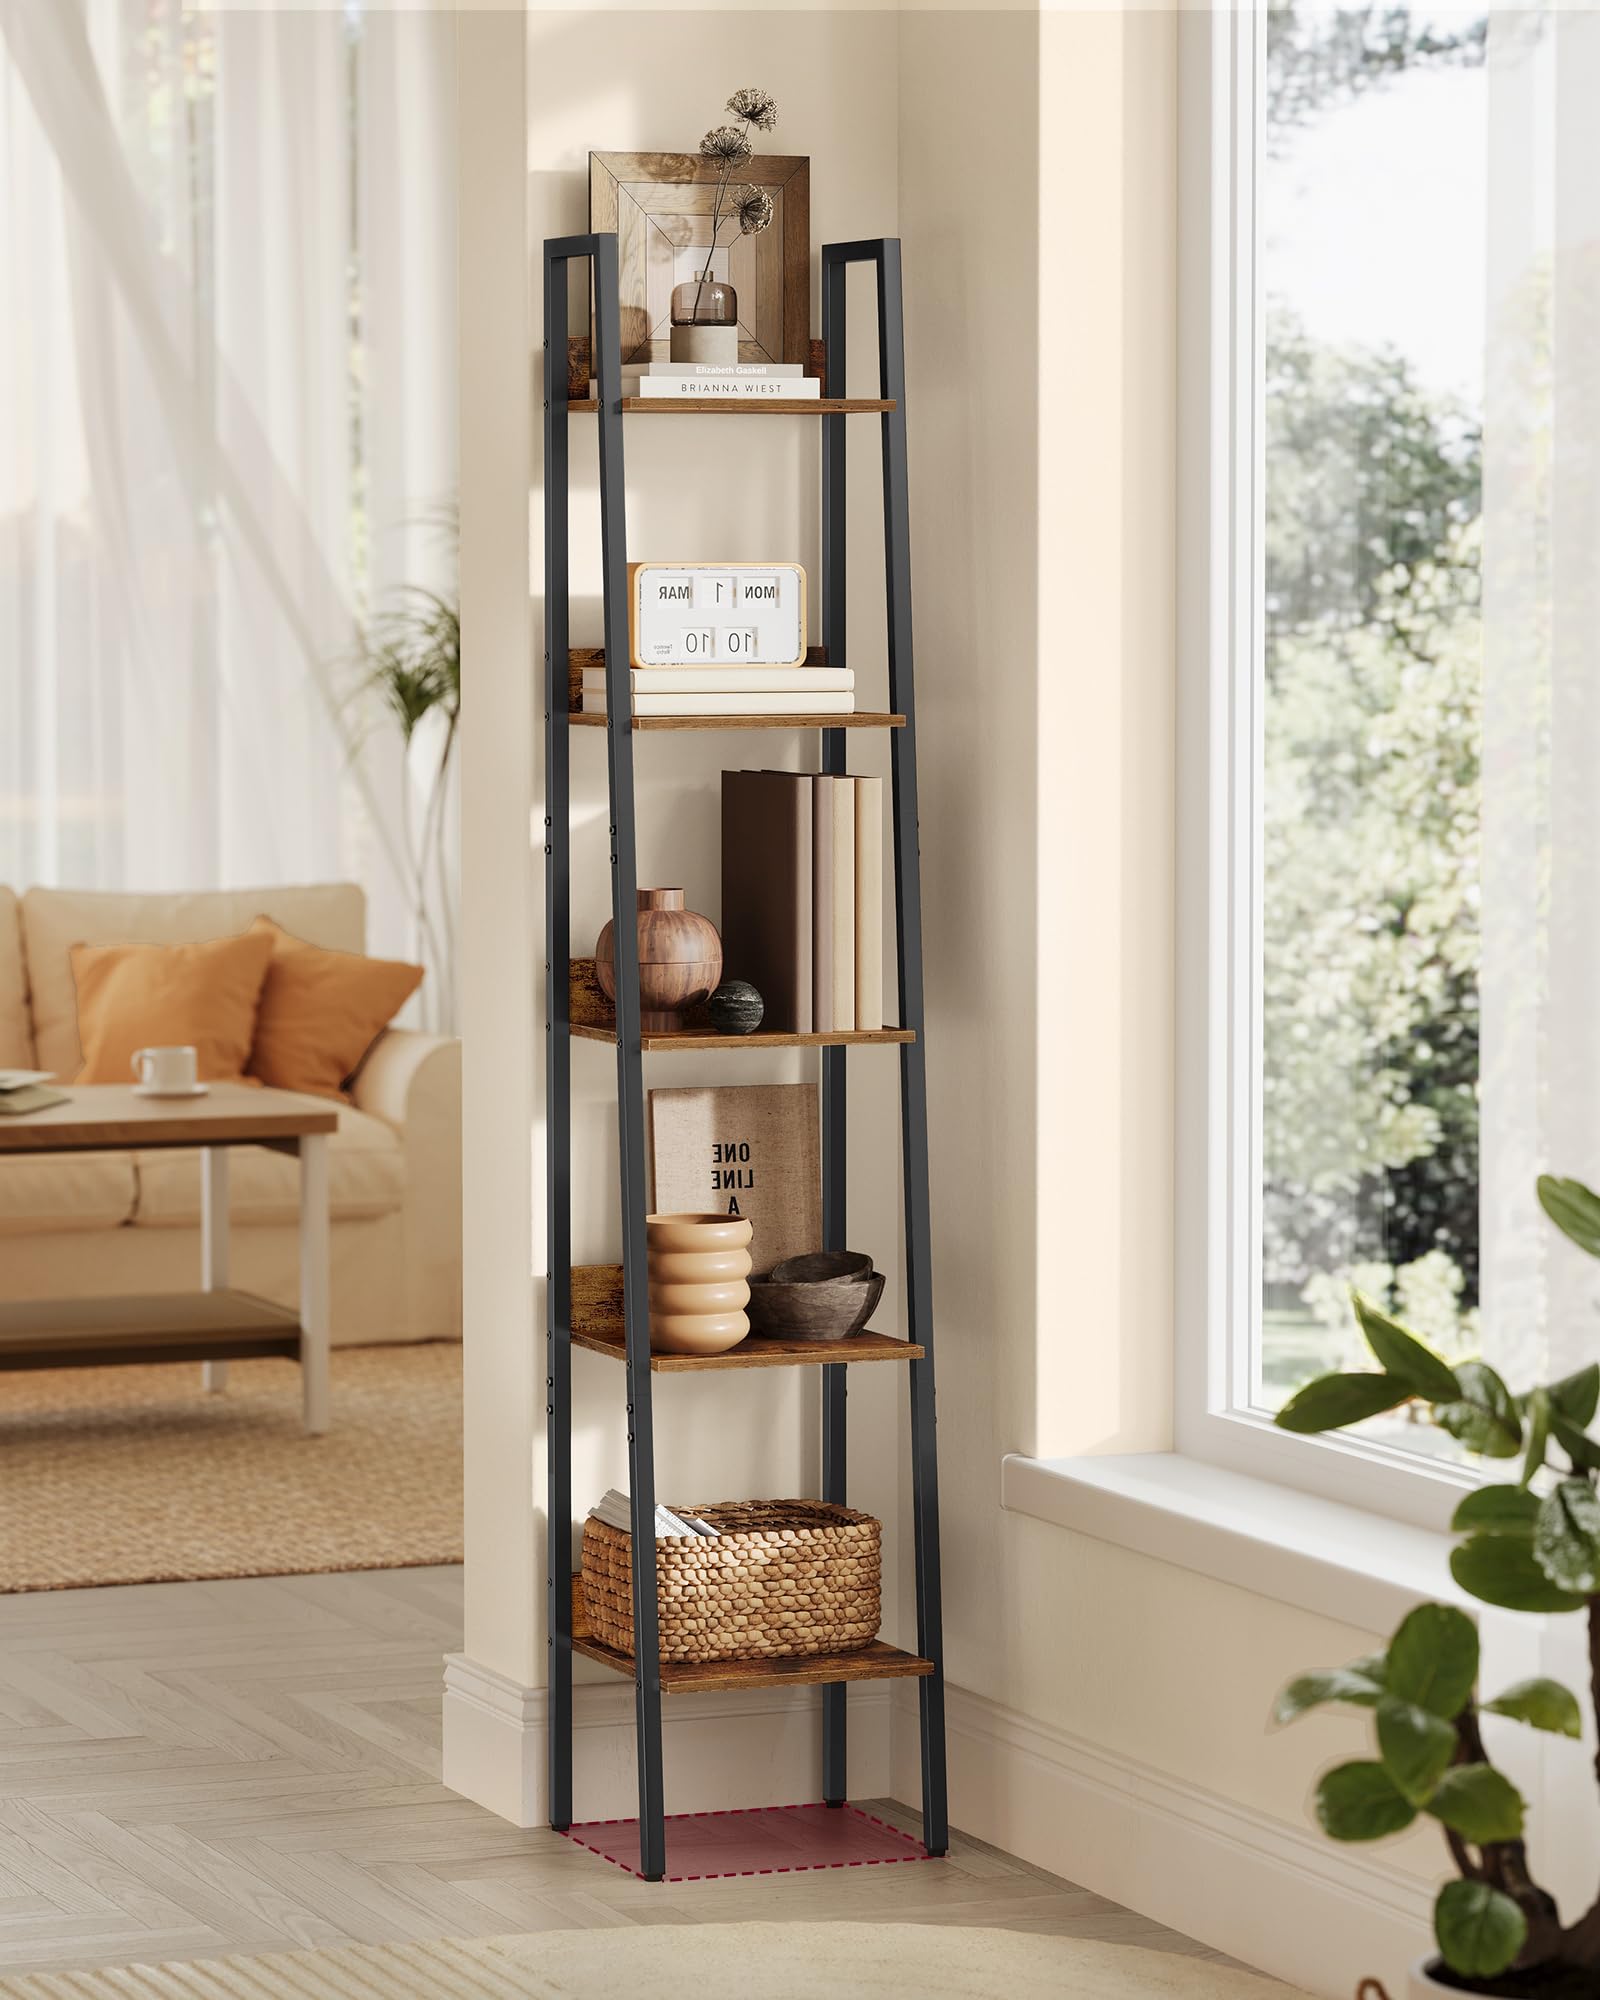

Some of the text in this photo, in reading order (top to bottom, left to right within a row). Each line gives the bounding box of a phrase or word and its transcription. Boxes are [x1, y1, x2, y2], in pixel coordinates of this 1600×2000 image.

[696, 366, 766, 375] Elizabeth Gaskell
[681, 383, 781, 393] BRIANNA WIEST
